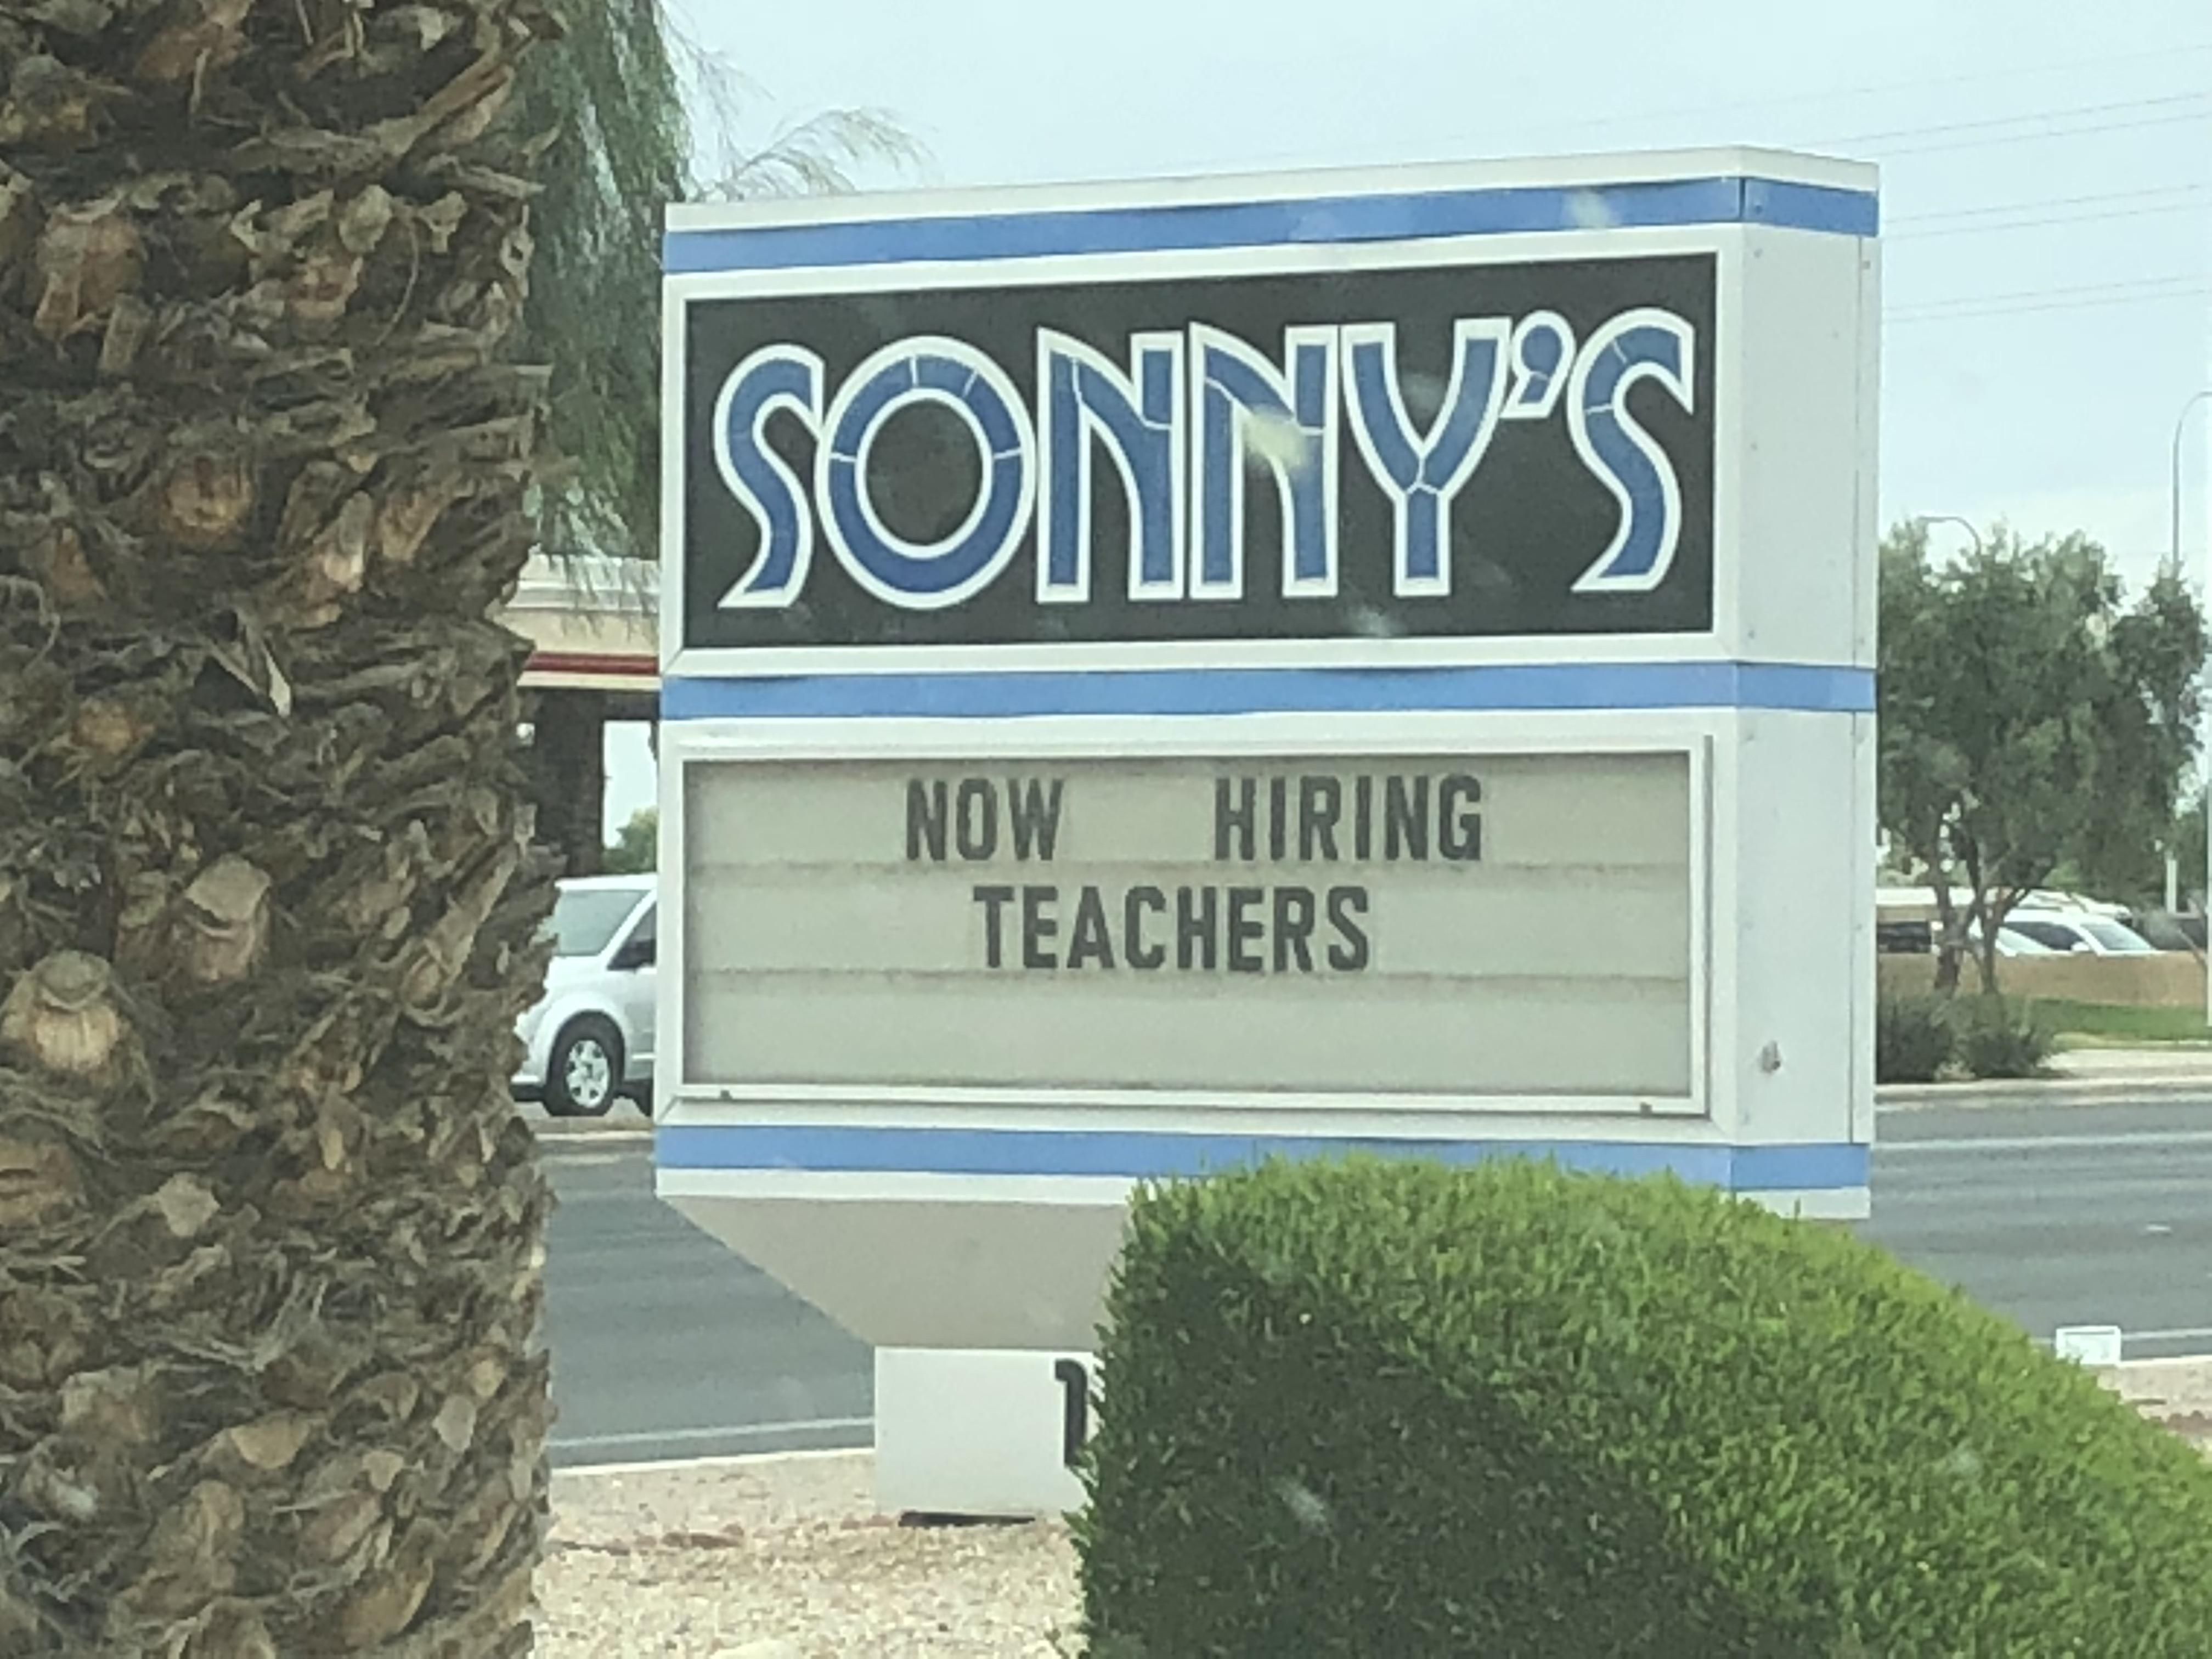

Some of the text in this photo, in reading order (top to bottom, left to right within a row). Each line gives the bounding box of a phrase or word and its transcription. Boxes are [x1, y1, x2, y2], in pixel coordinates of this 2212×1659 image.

[713, 307, 1696, 611] SONNY'S
[905, 773, 1483, 862] NOW HIRING
[972, 884, 1370, 973] TEACHERS
